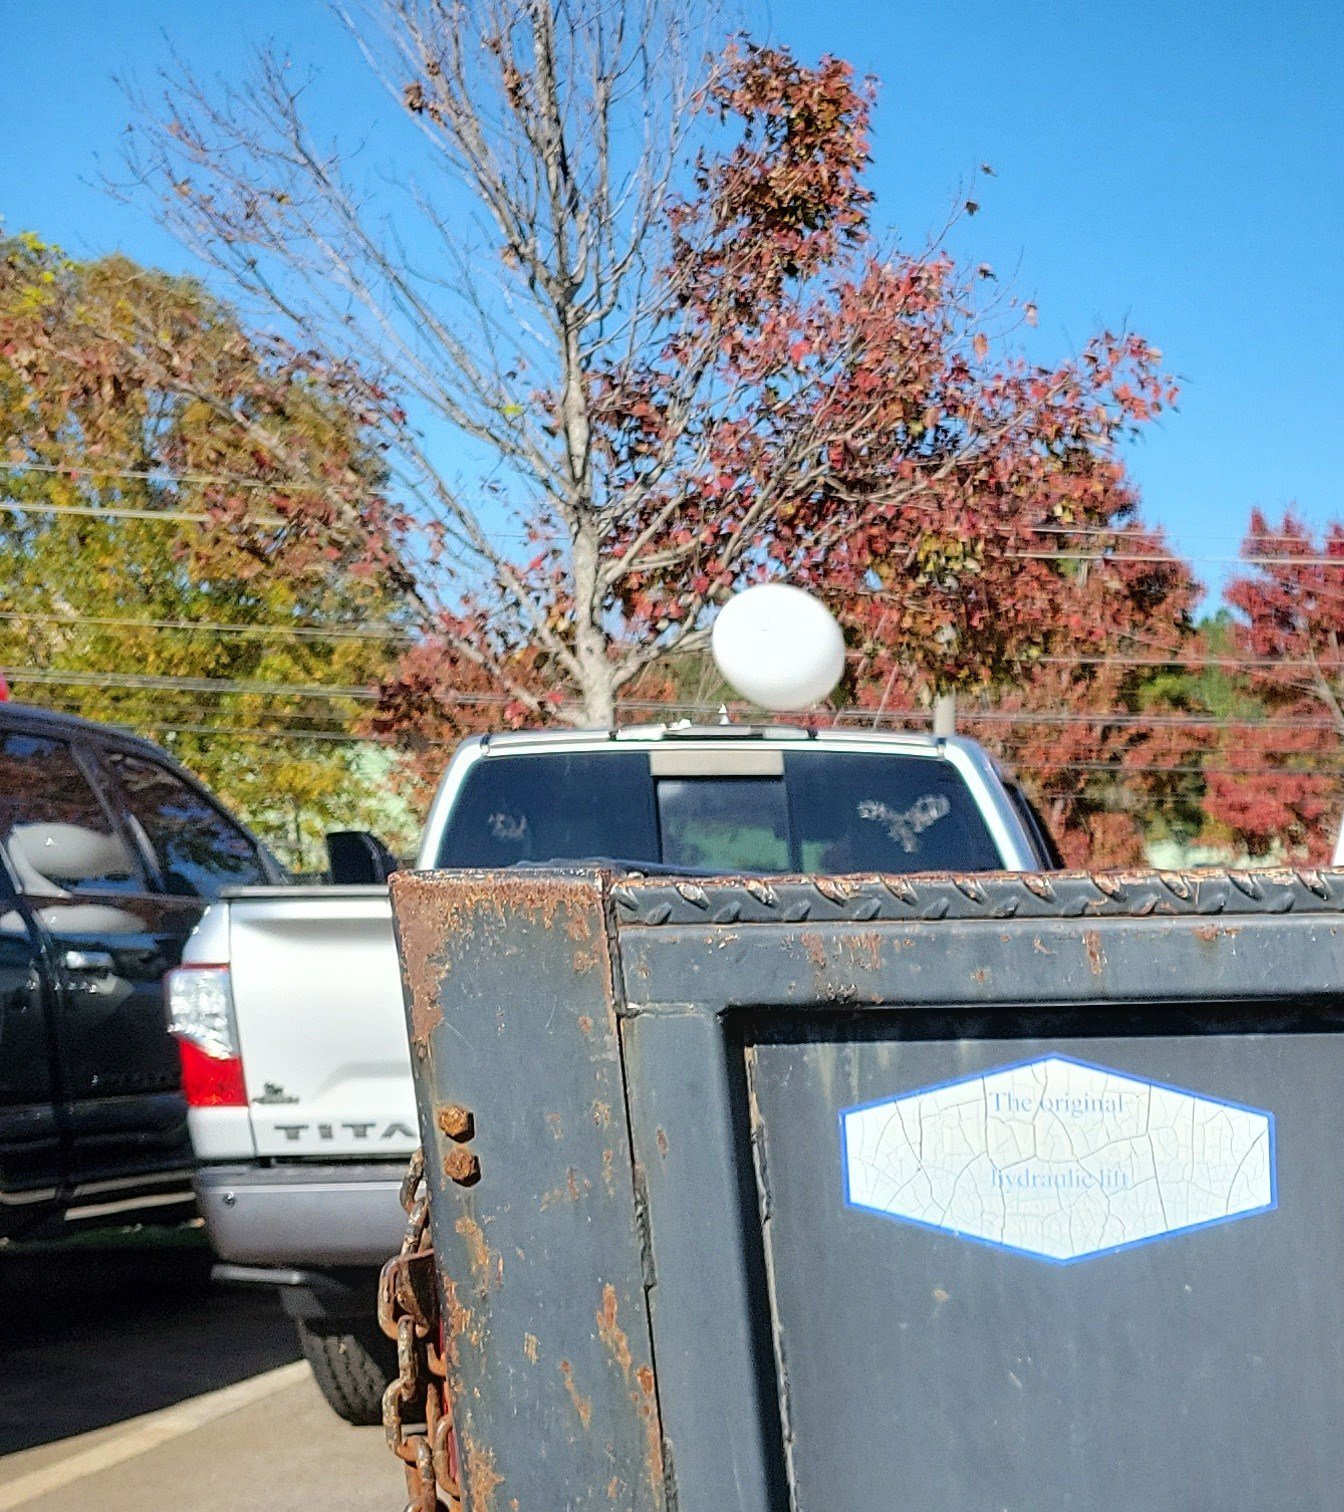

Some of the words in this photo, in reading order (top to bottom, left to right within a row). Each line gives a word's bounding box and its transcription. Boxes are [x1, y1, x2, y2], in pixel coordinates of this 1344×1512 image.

[990, 1092, 1034, 1114] The
[1040, 1092, 1123, 1118] original
[273, 1123, 418, 1140] TITA
[990, 1166, 1093, 1193] hydraulic
[1099, 1166, 1130, 1190] lift
